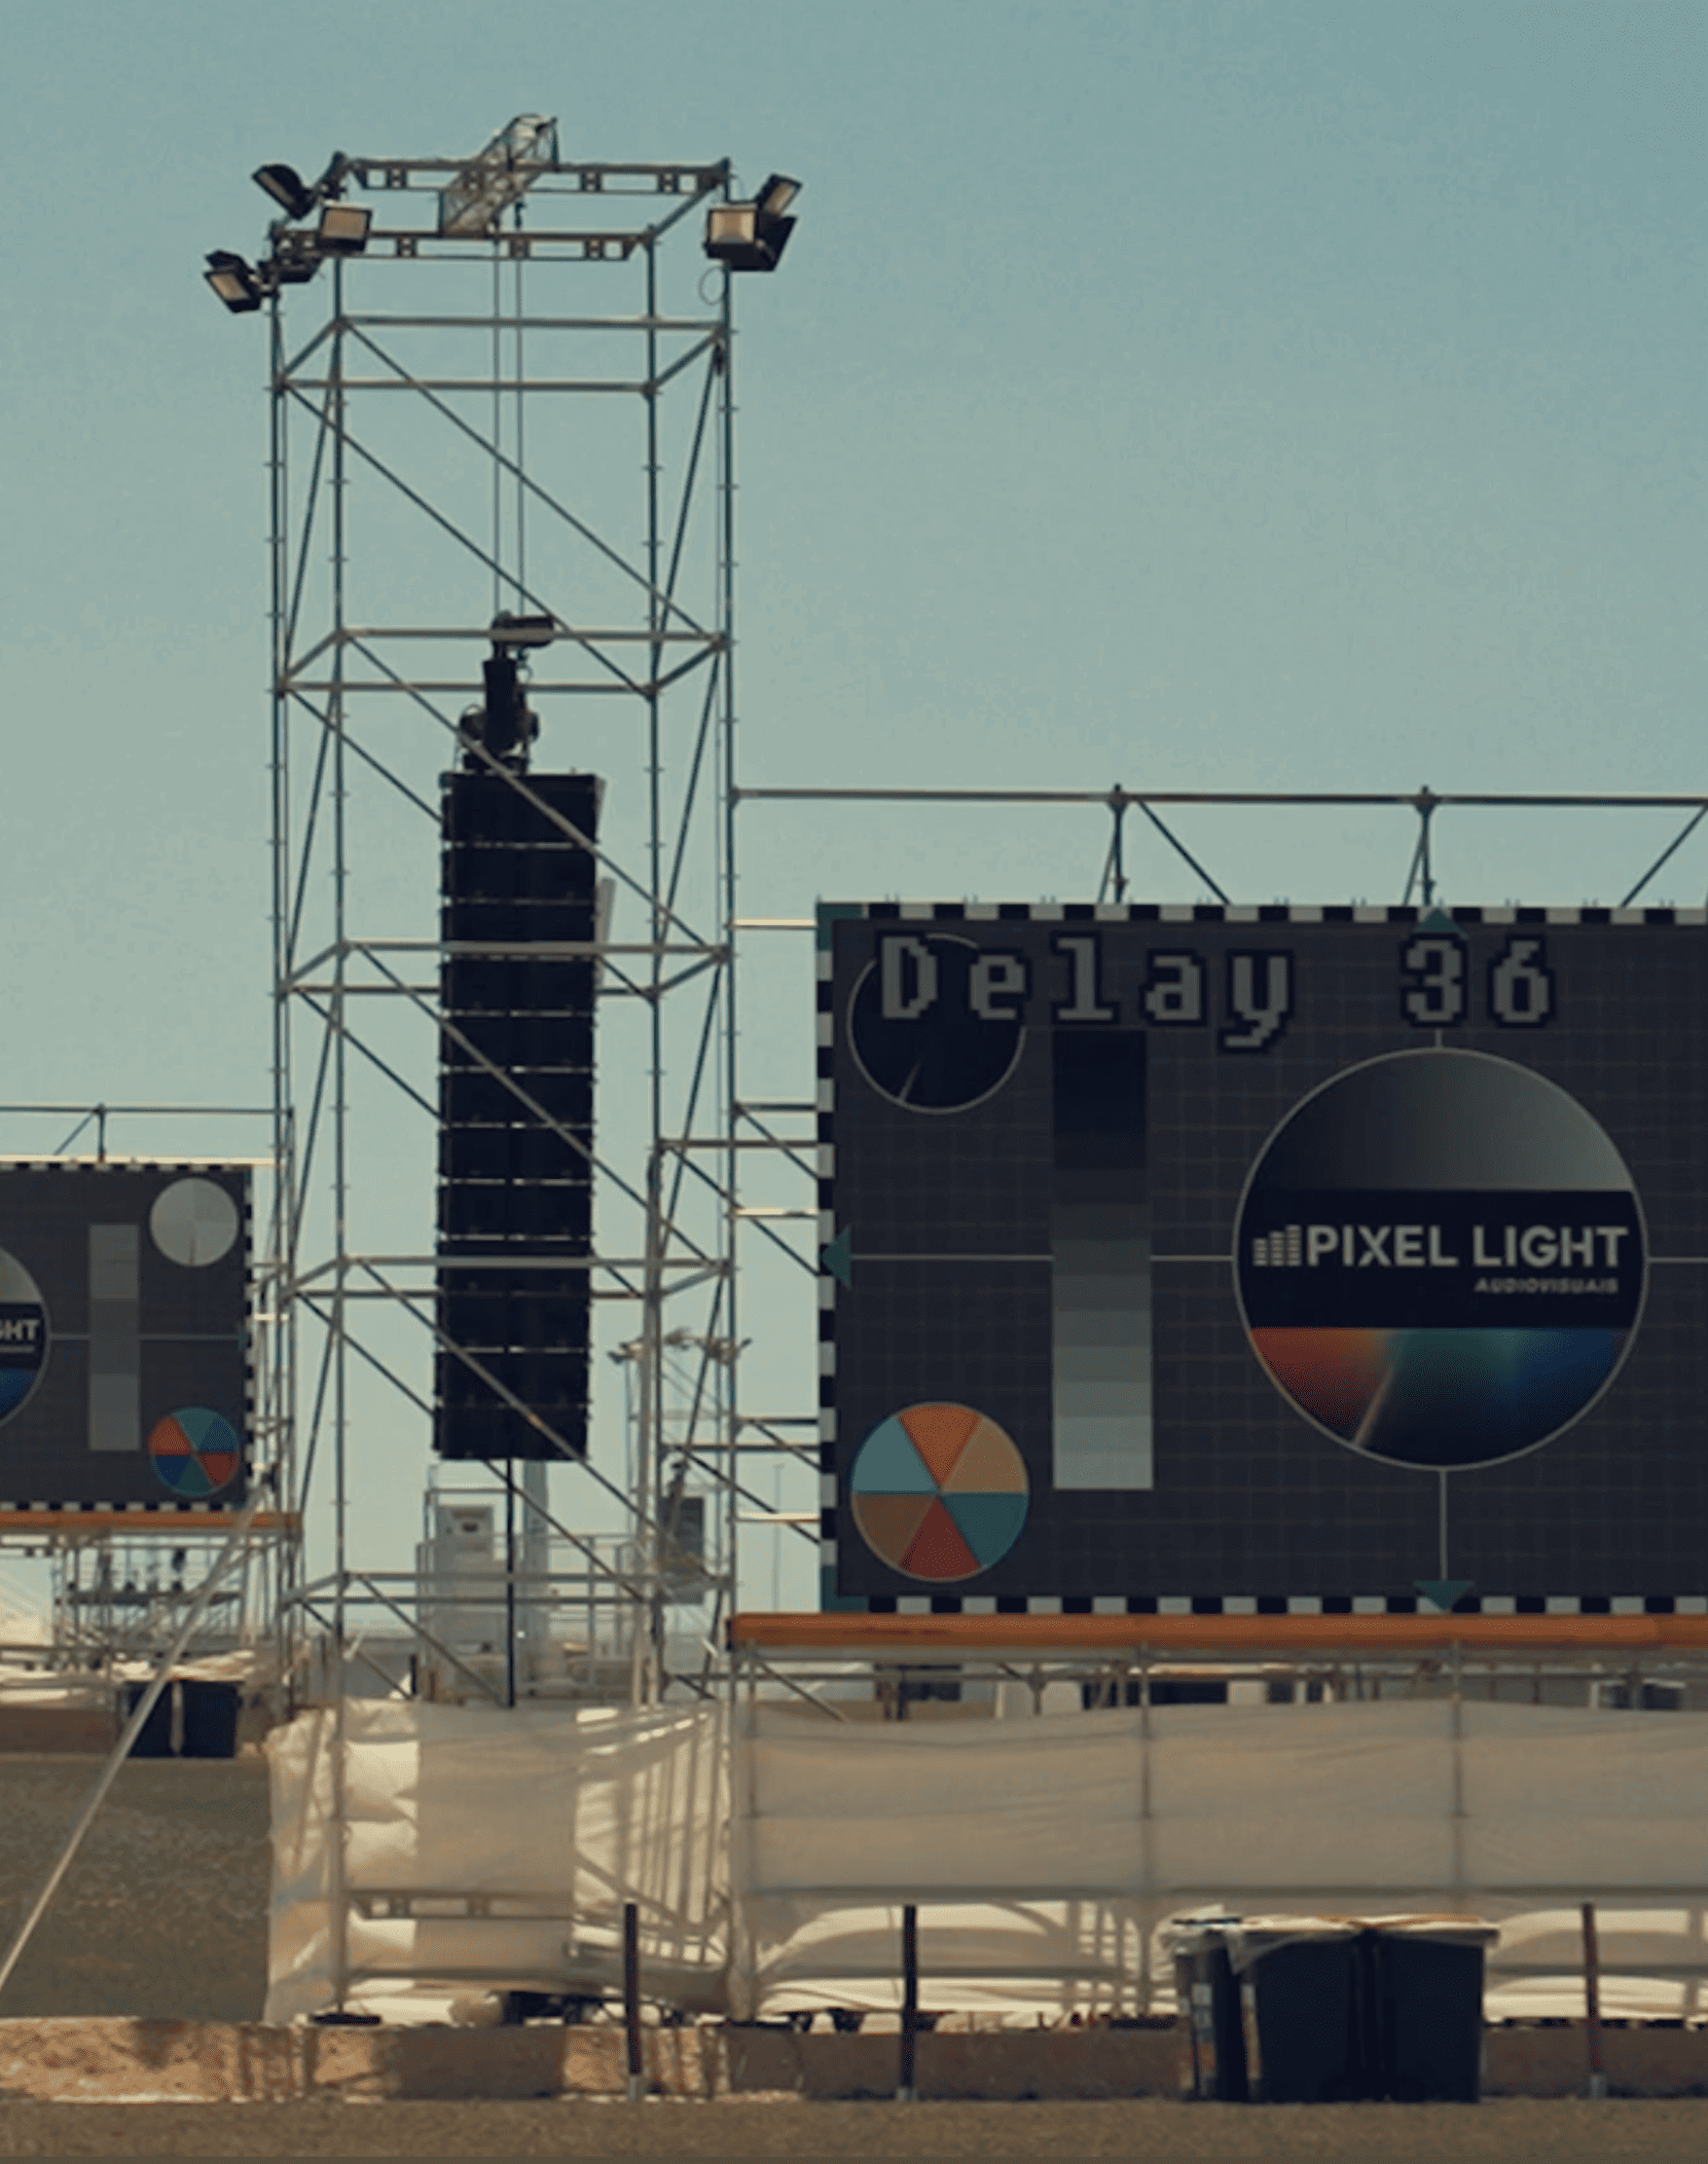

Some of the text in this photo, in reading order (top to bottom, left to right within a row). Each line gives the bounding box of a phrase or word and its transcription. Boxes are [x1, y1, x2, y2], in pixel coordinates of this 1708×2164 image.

[883, 936, 1549, 1047] Delay 36
[1306, 1225, 1628, 1266] PIXEL LIGHT
